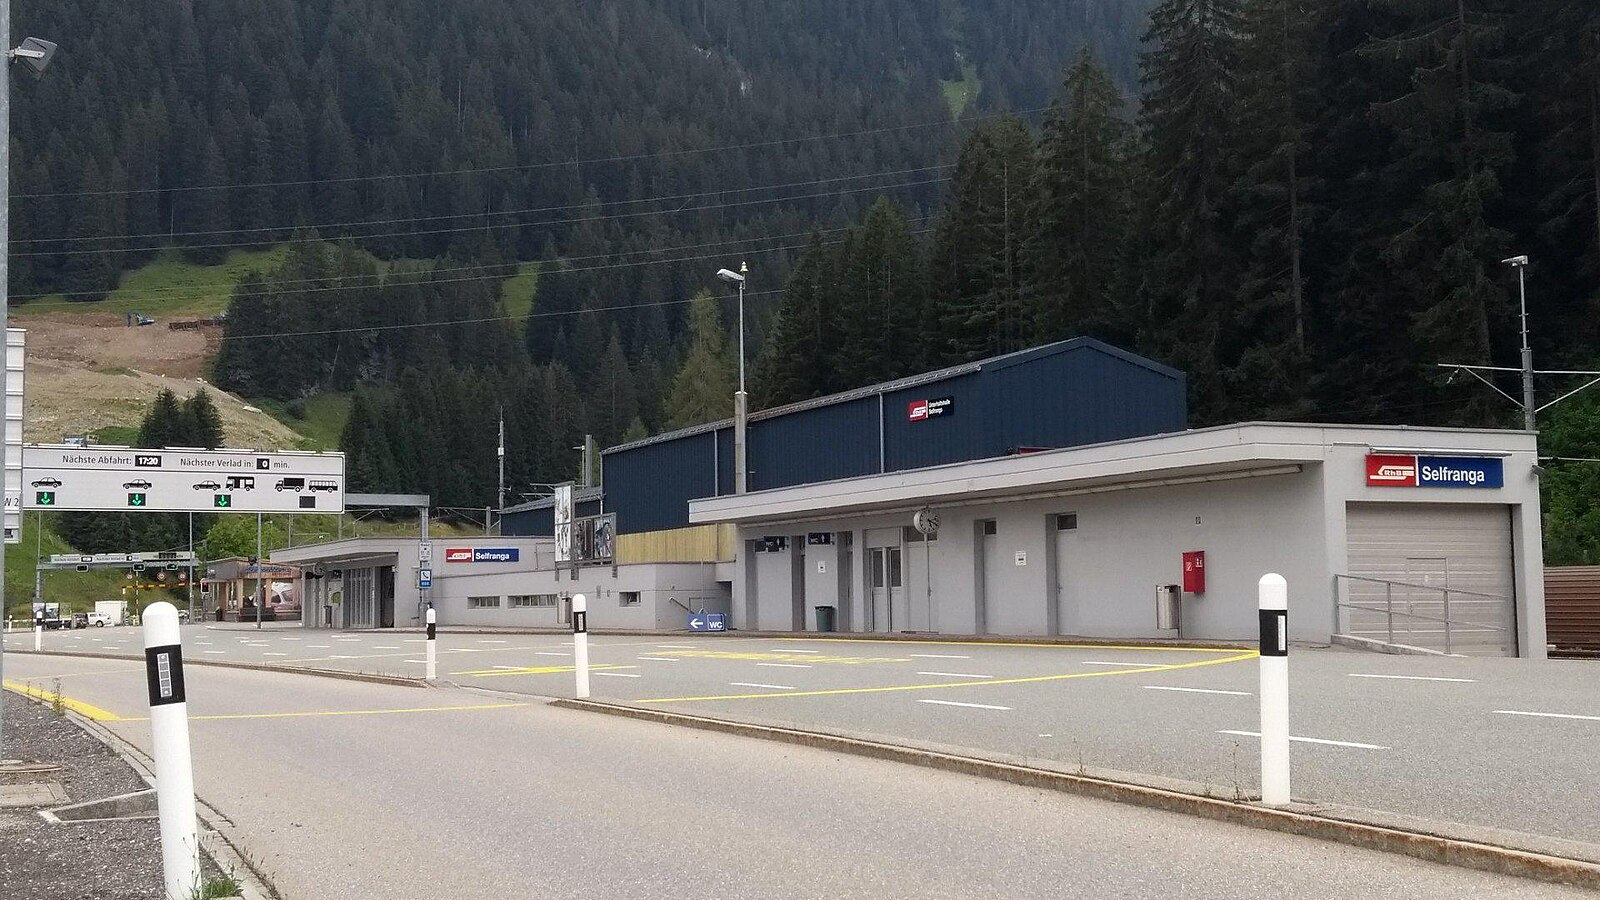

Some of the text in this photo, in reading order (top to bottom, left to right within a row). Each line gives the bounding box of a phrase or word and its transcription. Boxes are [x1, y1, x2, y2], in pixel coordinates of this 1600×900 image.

[62, 455, 132, 465] Nächste Abfahrt:
[138, 457, 159, 465] 17:20
[180, 458, 254, 468] Nächster Verlad in:
[262, 460, 268, 468] 0
[273, 460, 290, 469] min.
[1422, 465, 1485, 486] Selfranga
[14, 497, 19, 507] 2
[475, 552, 510, 562] Selfranga
[709, 621, 723, 629] WC
